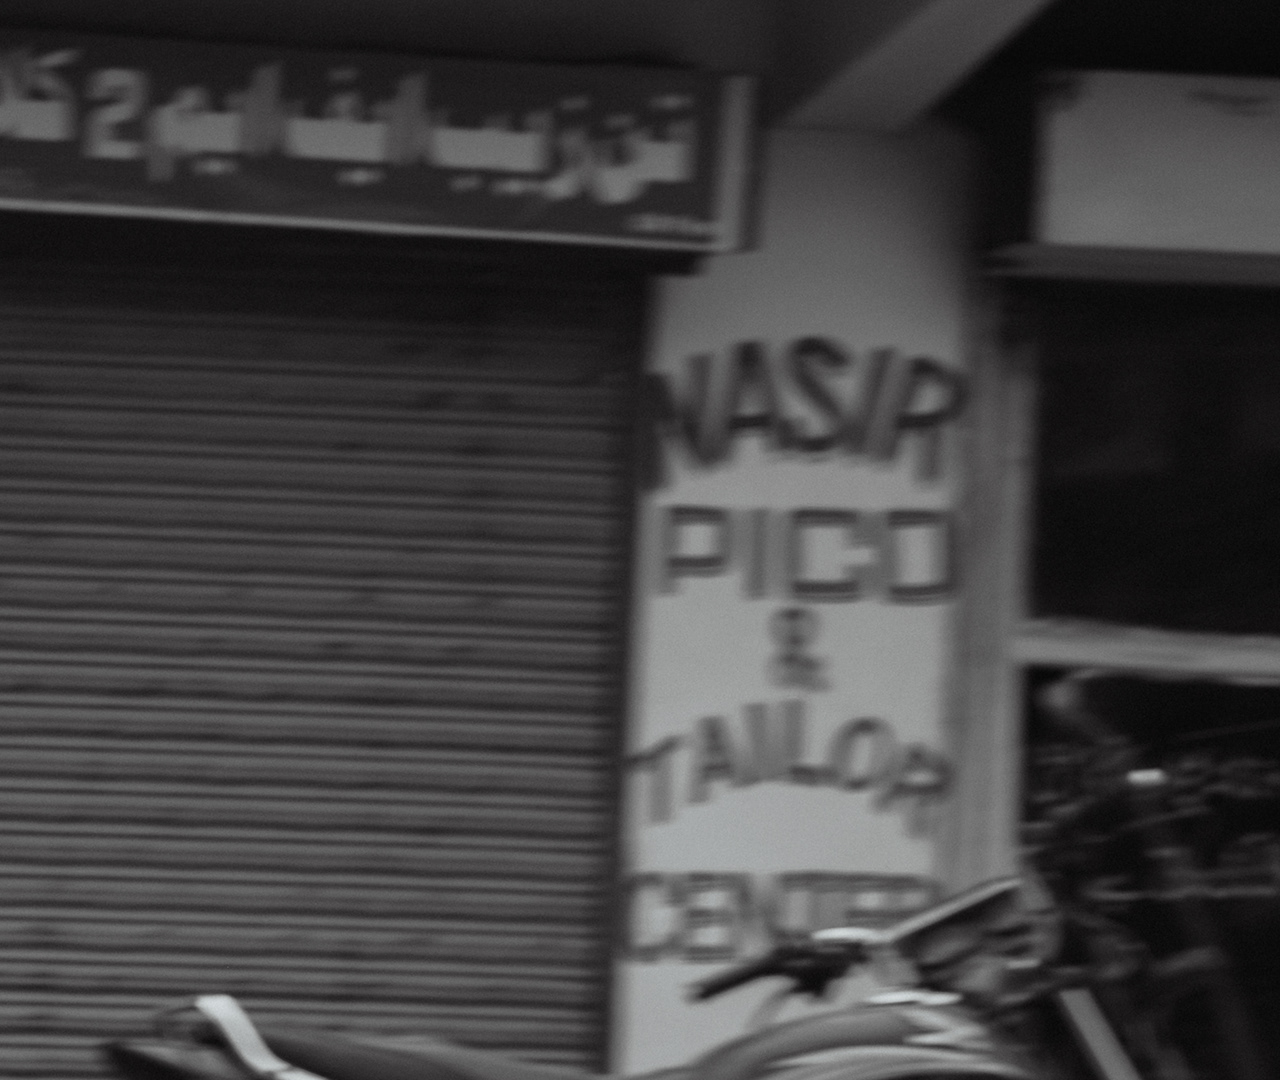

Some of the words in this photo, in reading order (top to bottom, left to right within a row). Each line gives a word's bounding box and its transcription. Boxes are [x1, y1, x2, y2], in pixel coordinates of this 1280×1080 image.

[83, 67, 149, 161] 2
[643, 334, 972, 490] NASIR
[655, 504, 962, 606] PICO
[626, 698, 954, 842] TAILOR
